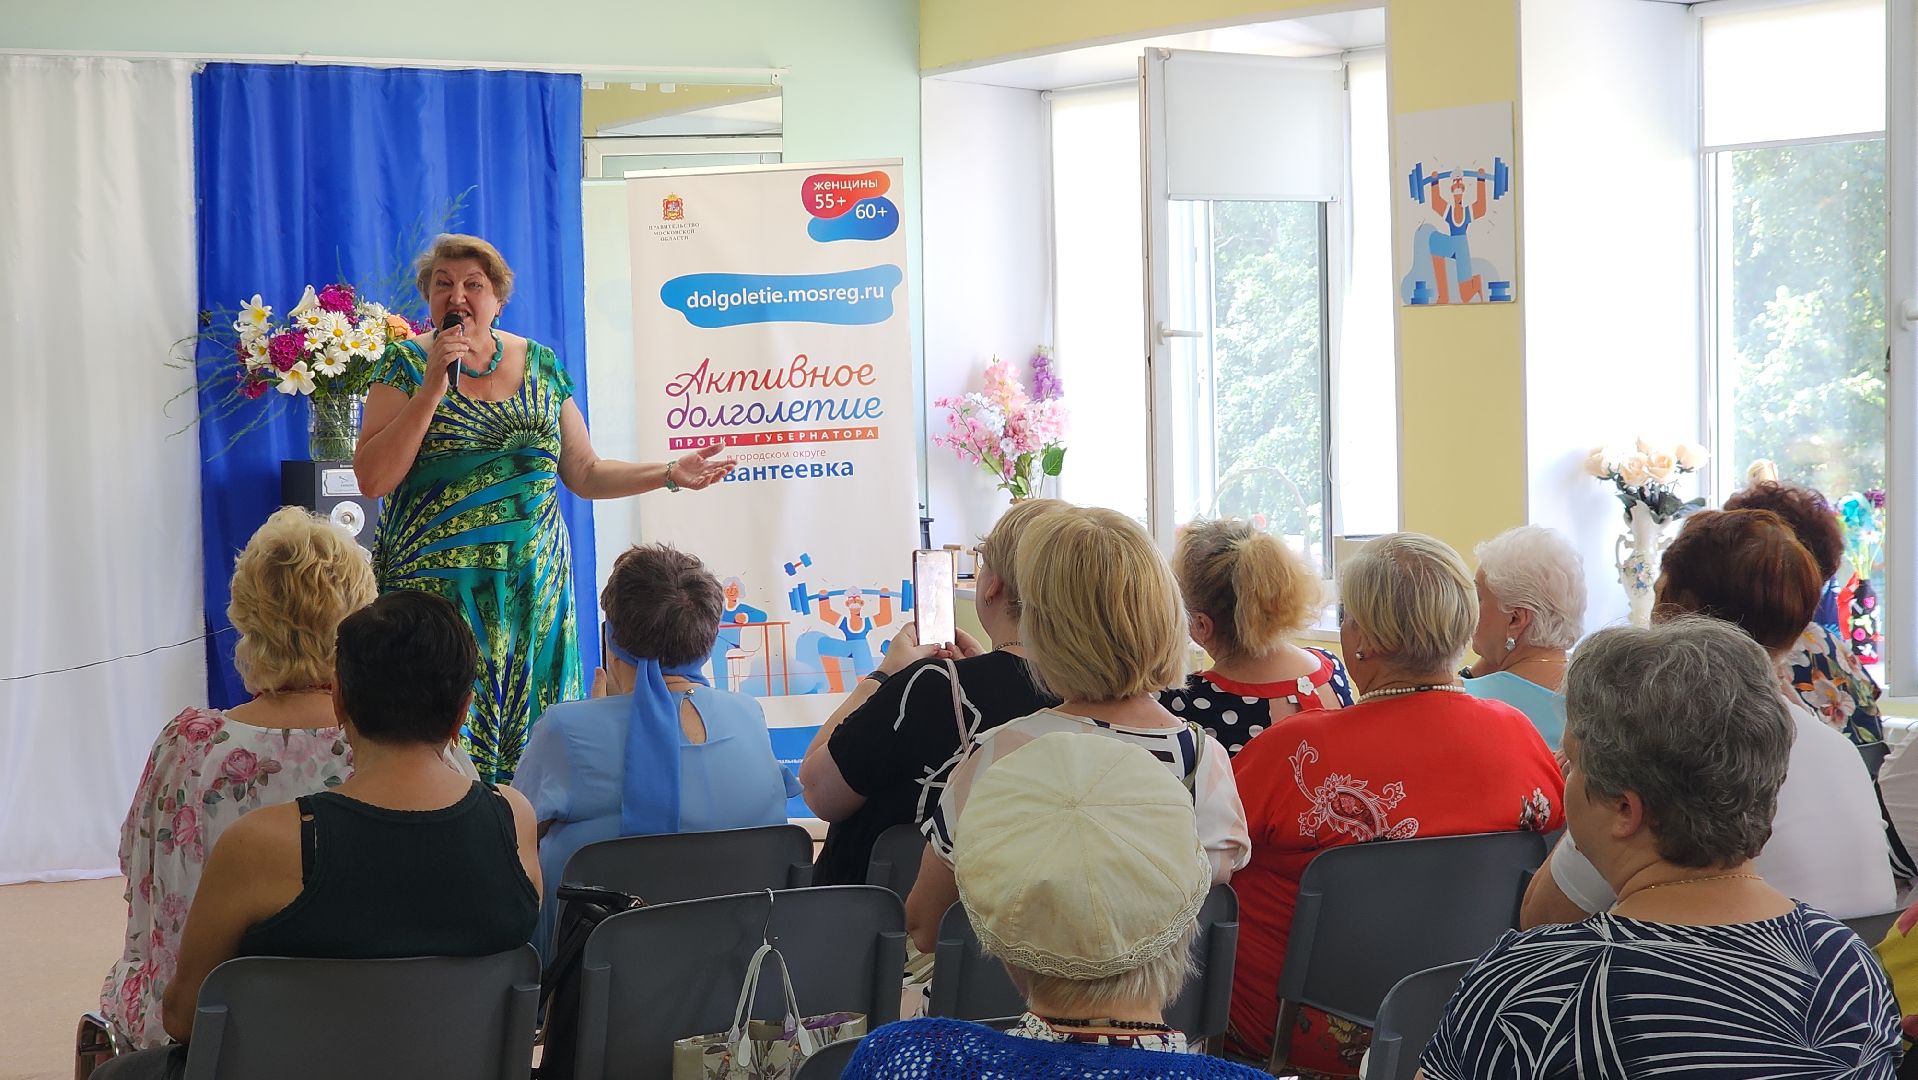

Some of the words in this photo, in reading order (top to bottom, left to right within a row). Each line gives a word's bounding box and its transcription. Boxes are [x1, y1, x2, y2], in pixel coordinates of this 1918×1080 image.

[813, 178, 878, 191] женщины
[815, 193, 847, 209] 55+
[855, 203, 888, 219] 60+
[686, 286, 884, 311] dolgoletie.mosreg.ru
[665, 353, 877, 397] Активное
[666, 392, 884, 429] долголетие
[675, 435, 738, 448] ПРОЕКТ
[754, 428, 875, 443] ГУБЕРНАТОРА
[735, 450, 790, 463] городском
[792, 448, 827, 459] округе
[722, 461, 854, 482] вантеевка
